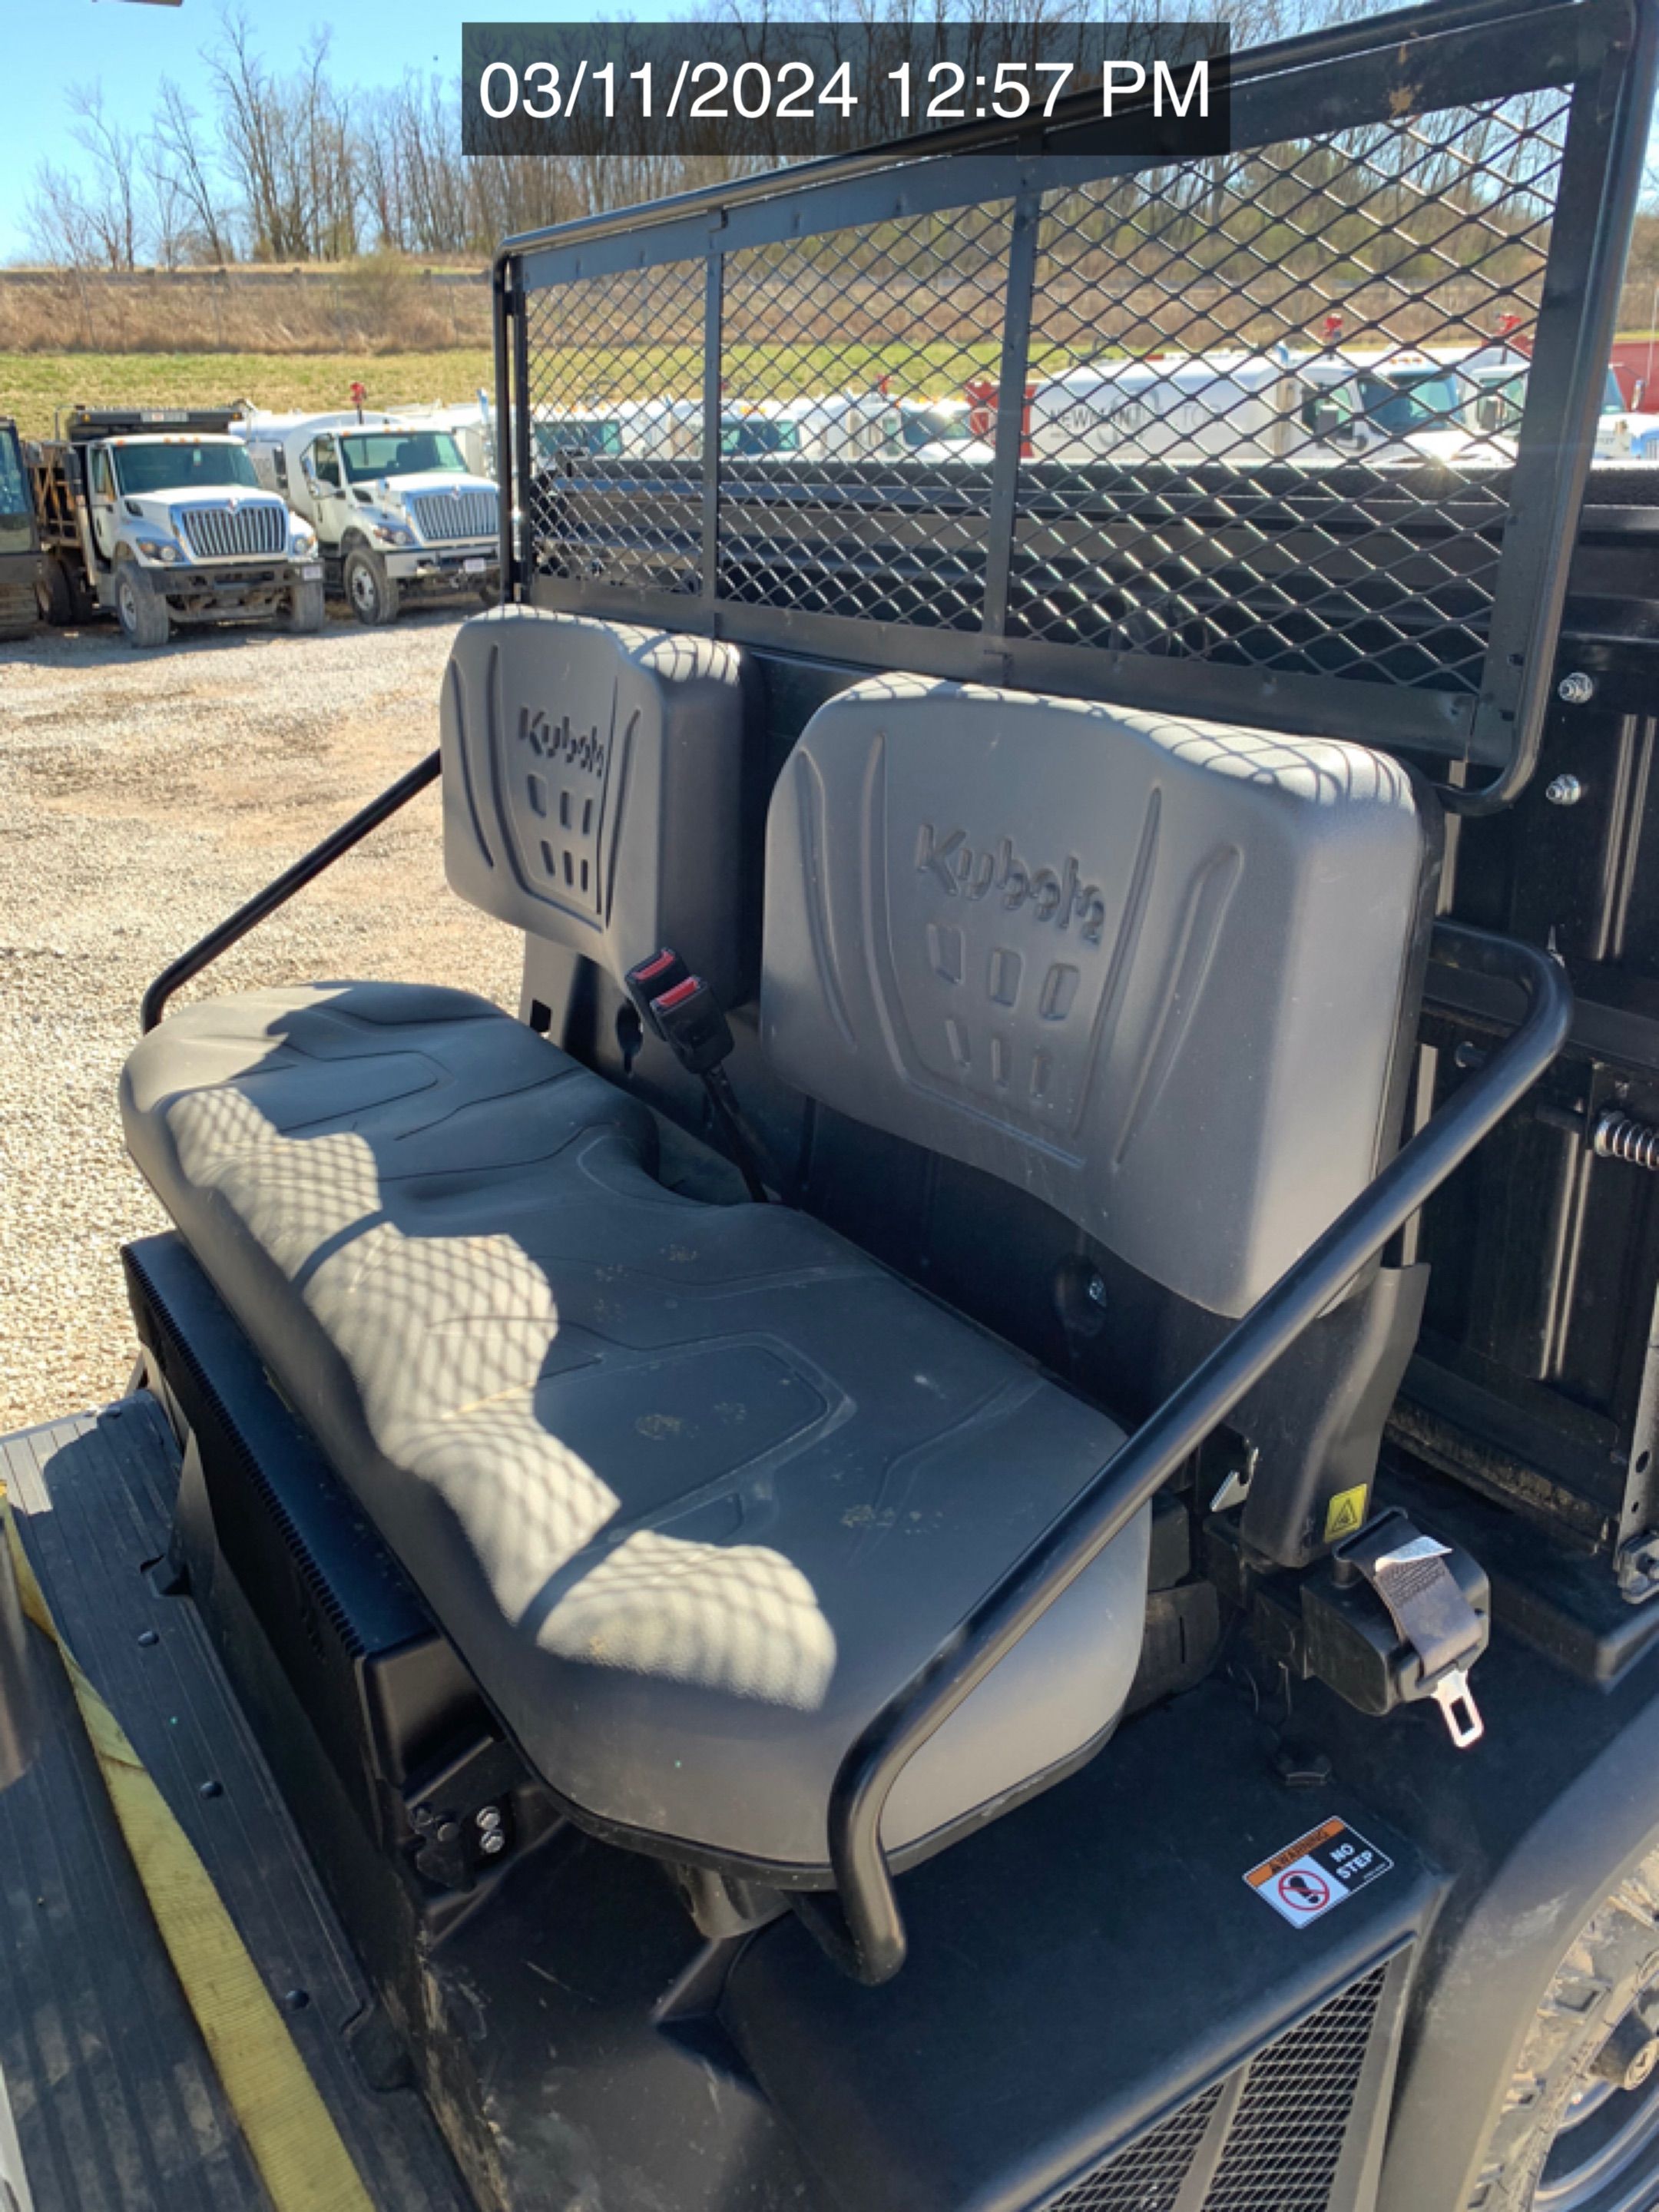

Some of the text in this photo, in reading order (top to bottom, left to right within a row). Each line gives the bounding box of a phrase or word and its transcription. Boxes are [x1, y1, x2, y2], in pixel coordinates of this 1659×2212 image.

[518, 705, 605, 779] Kubota
[916, 823, 1104, 946] Kubota
[1330, 1843, 1355, 1863] NO
[1336, 1849, 1373, 1879] STEP
